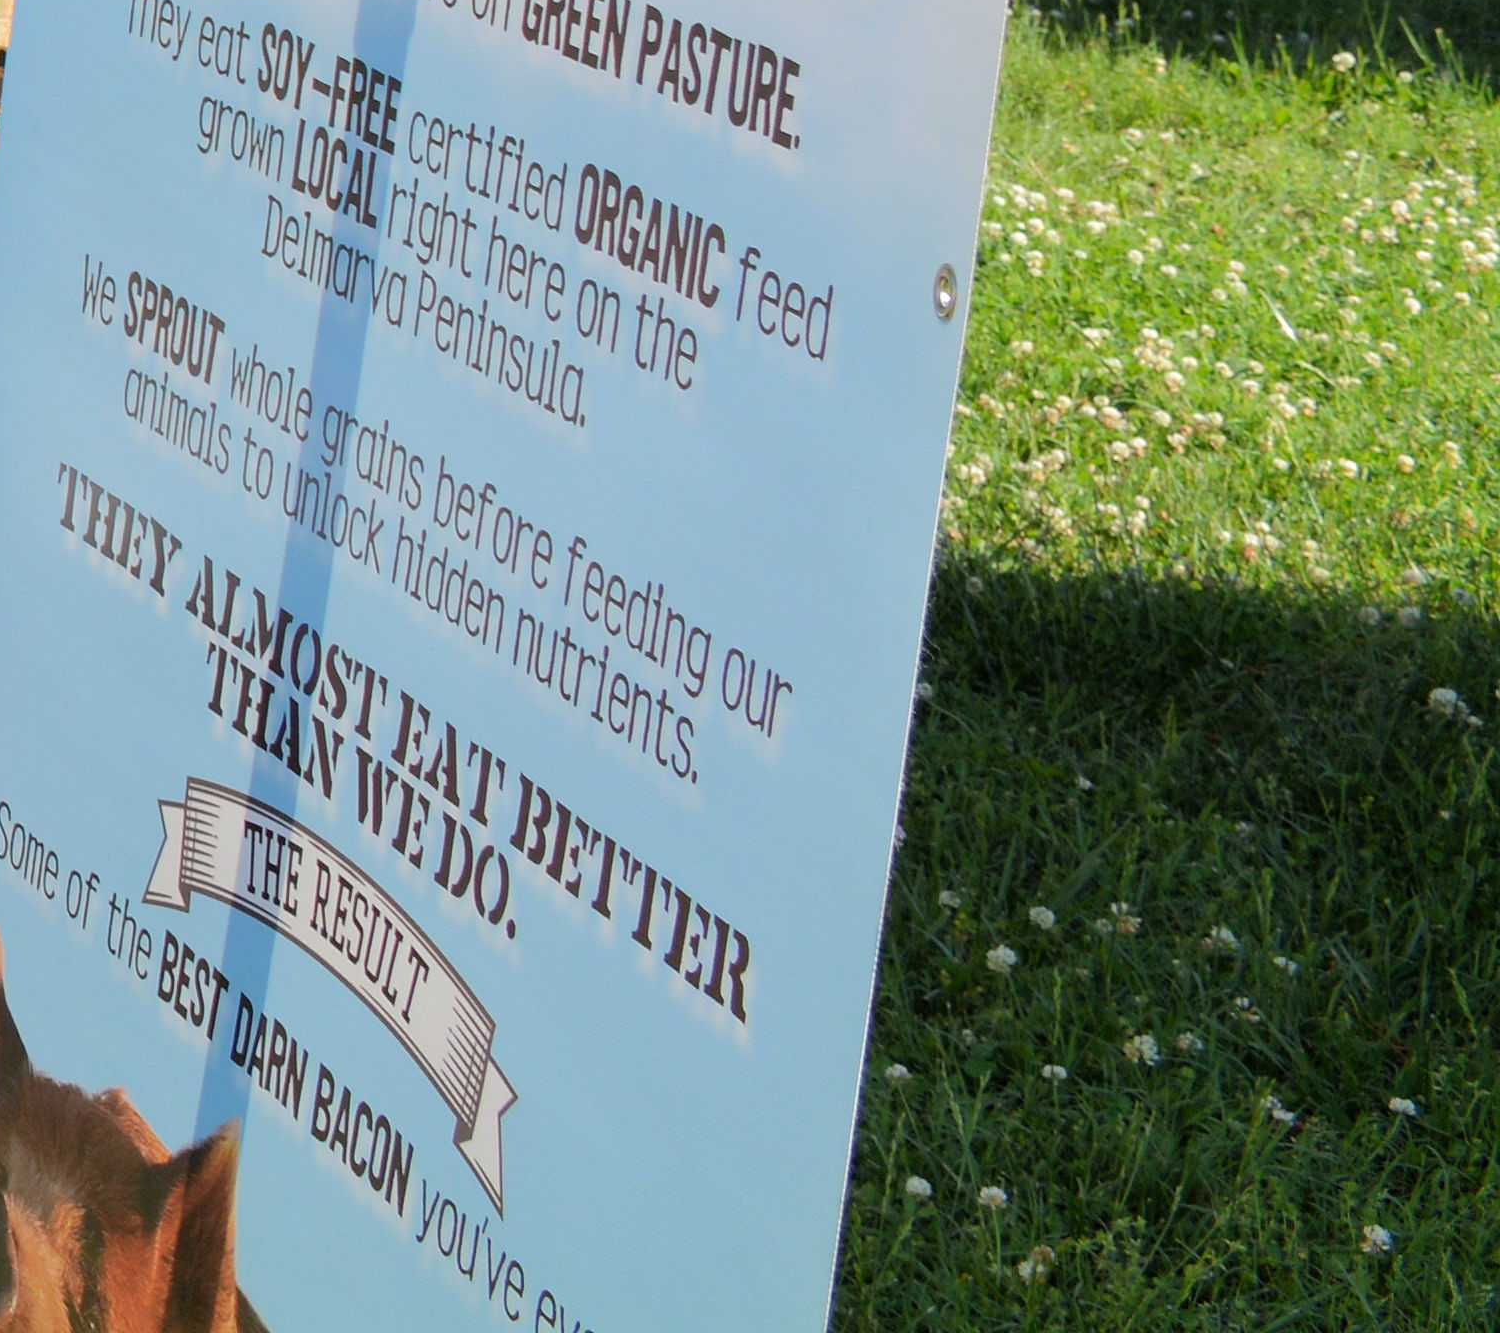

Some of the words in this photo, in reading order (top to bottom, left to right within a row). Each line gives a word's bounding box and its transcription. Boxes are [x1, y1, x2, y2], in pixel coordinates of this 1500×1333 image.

[199, 15, 250, 84] eat
[256, 22, 403, 156] SOY-FREE
[408, 107, 567, 233] certified
[575, 162, 726, 309] ORGANIC
[734, 245, 834, 362] feed
[636, 4, 801, 151] PASTURE.
[197, 95, 286, 185] grown
[291, 119, 380, 228] LOCAL
[387, 175, 478, 278] right
[488, 220, 567, 323] here
[577, 278, 620, 337] on
[634, 297, 698, 392] the
[262, 195, 408, 327] Delmarva
[413, 269, 586, 428] Peninsula.
[82, 254, 117, 327] We
[124, 271, 225, 386] SPROUT
[231, 344, 312, 442] whole
[321, 403, 426, 512] grains
[436, 454, 555, 589] before
[564, 536, 712, 699] feeding
[721, 645, 793, 738] our
[124, 366, 231, 474] animals
[241, 427, 274, 500] to
[281, 467, 386, 575] unlock
[391, 514, 505, 655] hidden
[513, 609, 700, 785] nutrients.
[57, 461, 183, 599] THEY
[187, 554, 388, 738] ALMOST
[391, 689, 507, 827] EAT
[509, 772, 754, 1025] BETTER
[205, 641, 344, 801] THAN
[354, 744, 429, 870] WE
[433, 810, 517, 941] DO.
[243, 821, 302, 914] THE
[309, 842, 432, 1024] RESULT
[66, 868, 101, 930] of
[106, 892, 154, 981] the
[157, 928, 230, 1042] BEST
[230, 990, 310, 1123] DARN
[310, 1062, 415, 1218] BACON
[415, 1176, 527, 1321] you've
